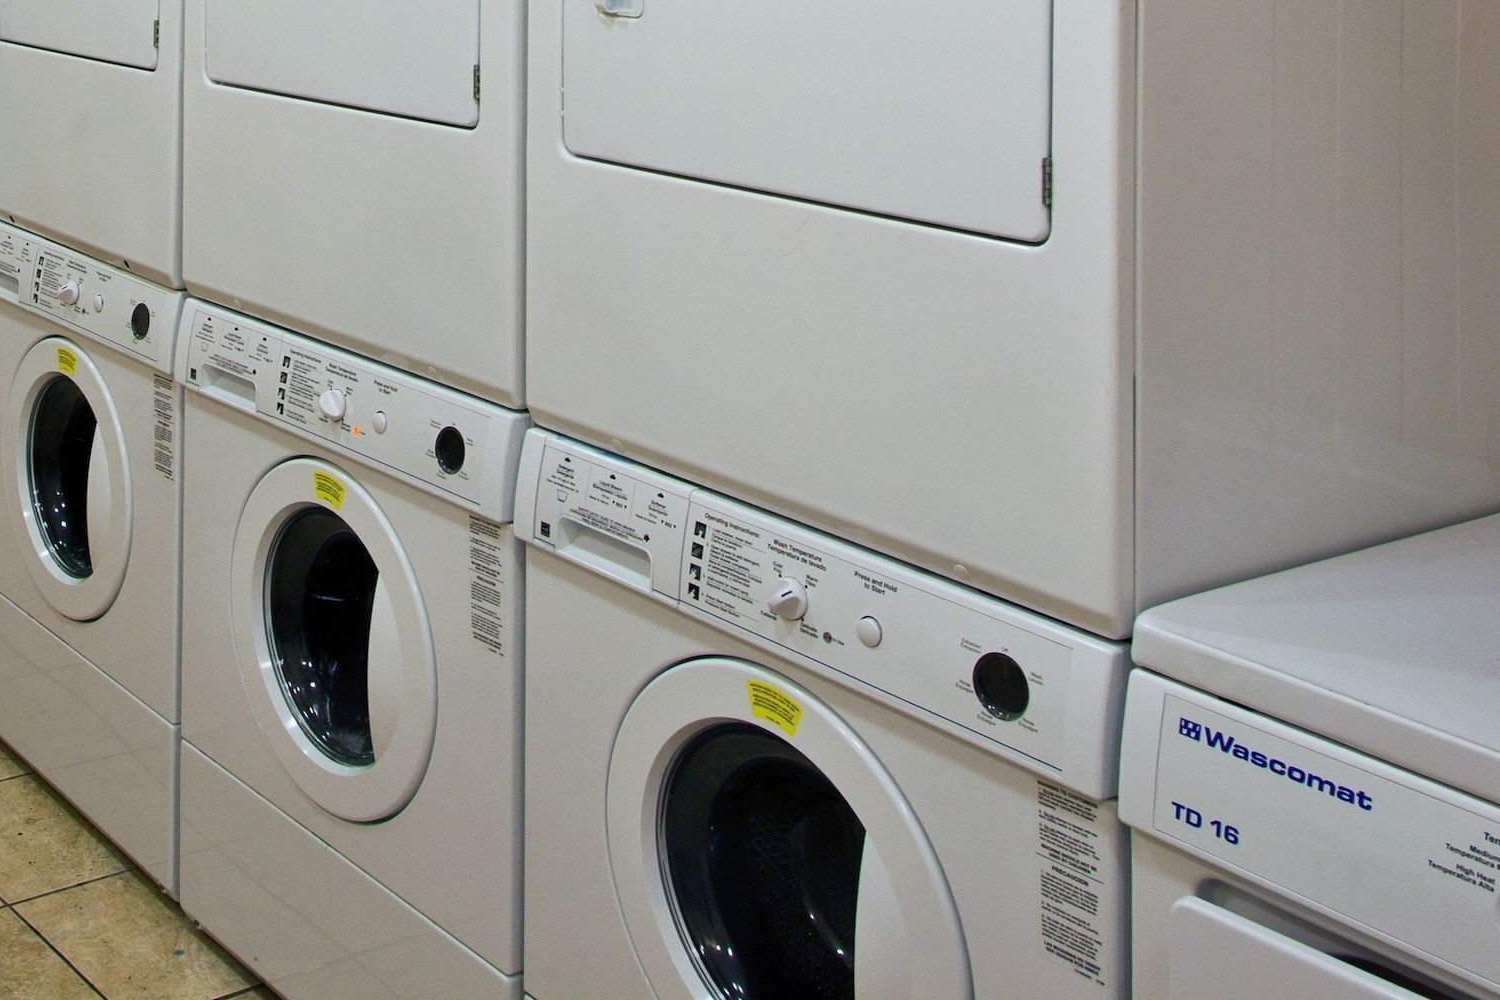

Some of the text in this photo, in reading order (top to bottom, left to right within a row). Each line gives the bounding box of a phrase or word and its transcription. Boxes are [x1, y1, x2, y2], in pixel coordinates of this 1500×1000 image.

[705, 513, 728, 526] Operating
[768, 544, 800, 561] Temperatura
[808, 560, 826, 571] lavado
[774, 540, 822, 562] Wash Temperature
[855, 571, 898, 593] Press and Hold
[871, 585, 886, 596] Start
[1204, 726, 1373, 811] Wascomat
[1170, 800, 1239, 845] TD 16
[1445, 842, 1495, 868] Temperatura
[1428, 859, 1494, 892] Temperatura Alta
[1456, 863, 1495, 885] High Heat
